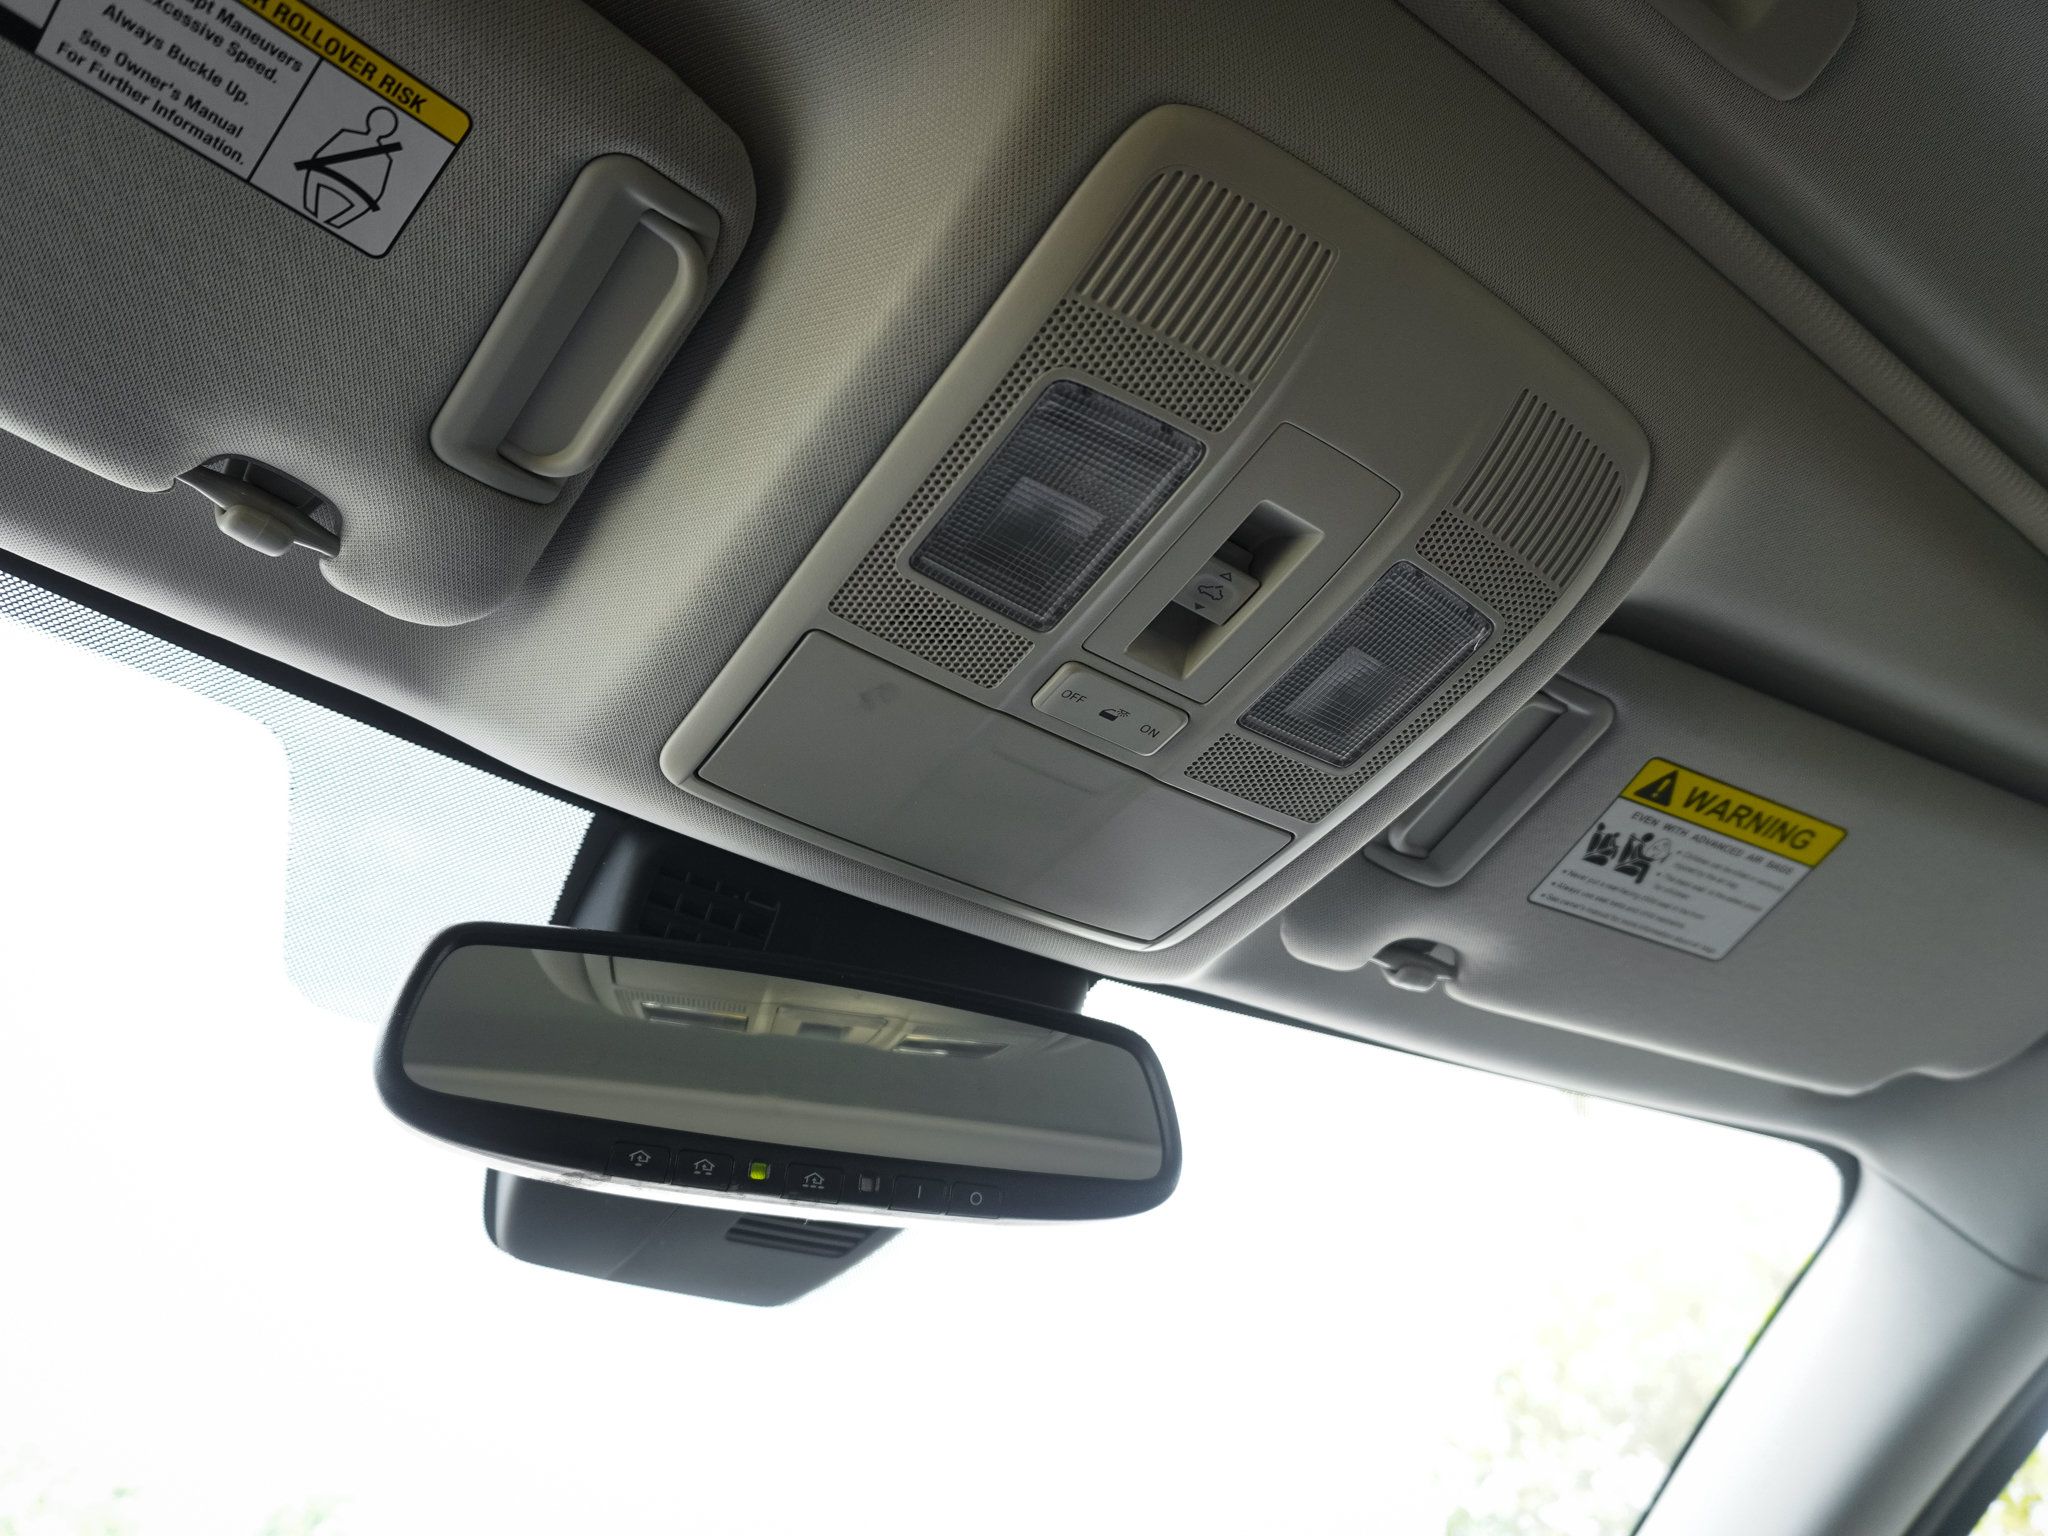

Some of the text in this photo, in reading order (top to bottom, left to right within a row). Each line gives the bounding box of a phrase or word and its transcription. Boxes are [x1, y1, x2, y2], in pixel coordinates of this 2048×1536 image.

[102, 3, 250, 106] Always Buckle Up.
[145, 0, 278, 85] xcessive Speed.
[214, 8, 304, 74] Maneuvers
[272, 3, 428, 115] ROLLOVER RISK
[55, 40, 245, 166] For Further Information.
[78, 28, 245, 140] See Owner's Manual
[1061, 689, 1088, 703] OFF
[1139, 723, 1160, 739] ON
[1631, 811, 1659, 827] EVEN
[1661, 822, 1689, 838] WITH
[1683, 785, 1817, 851] WARNING
